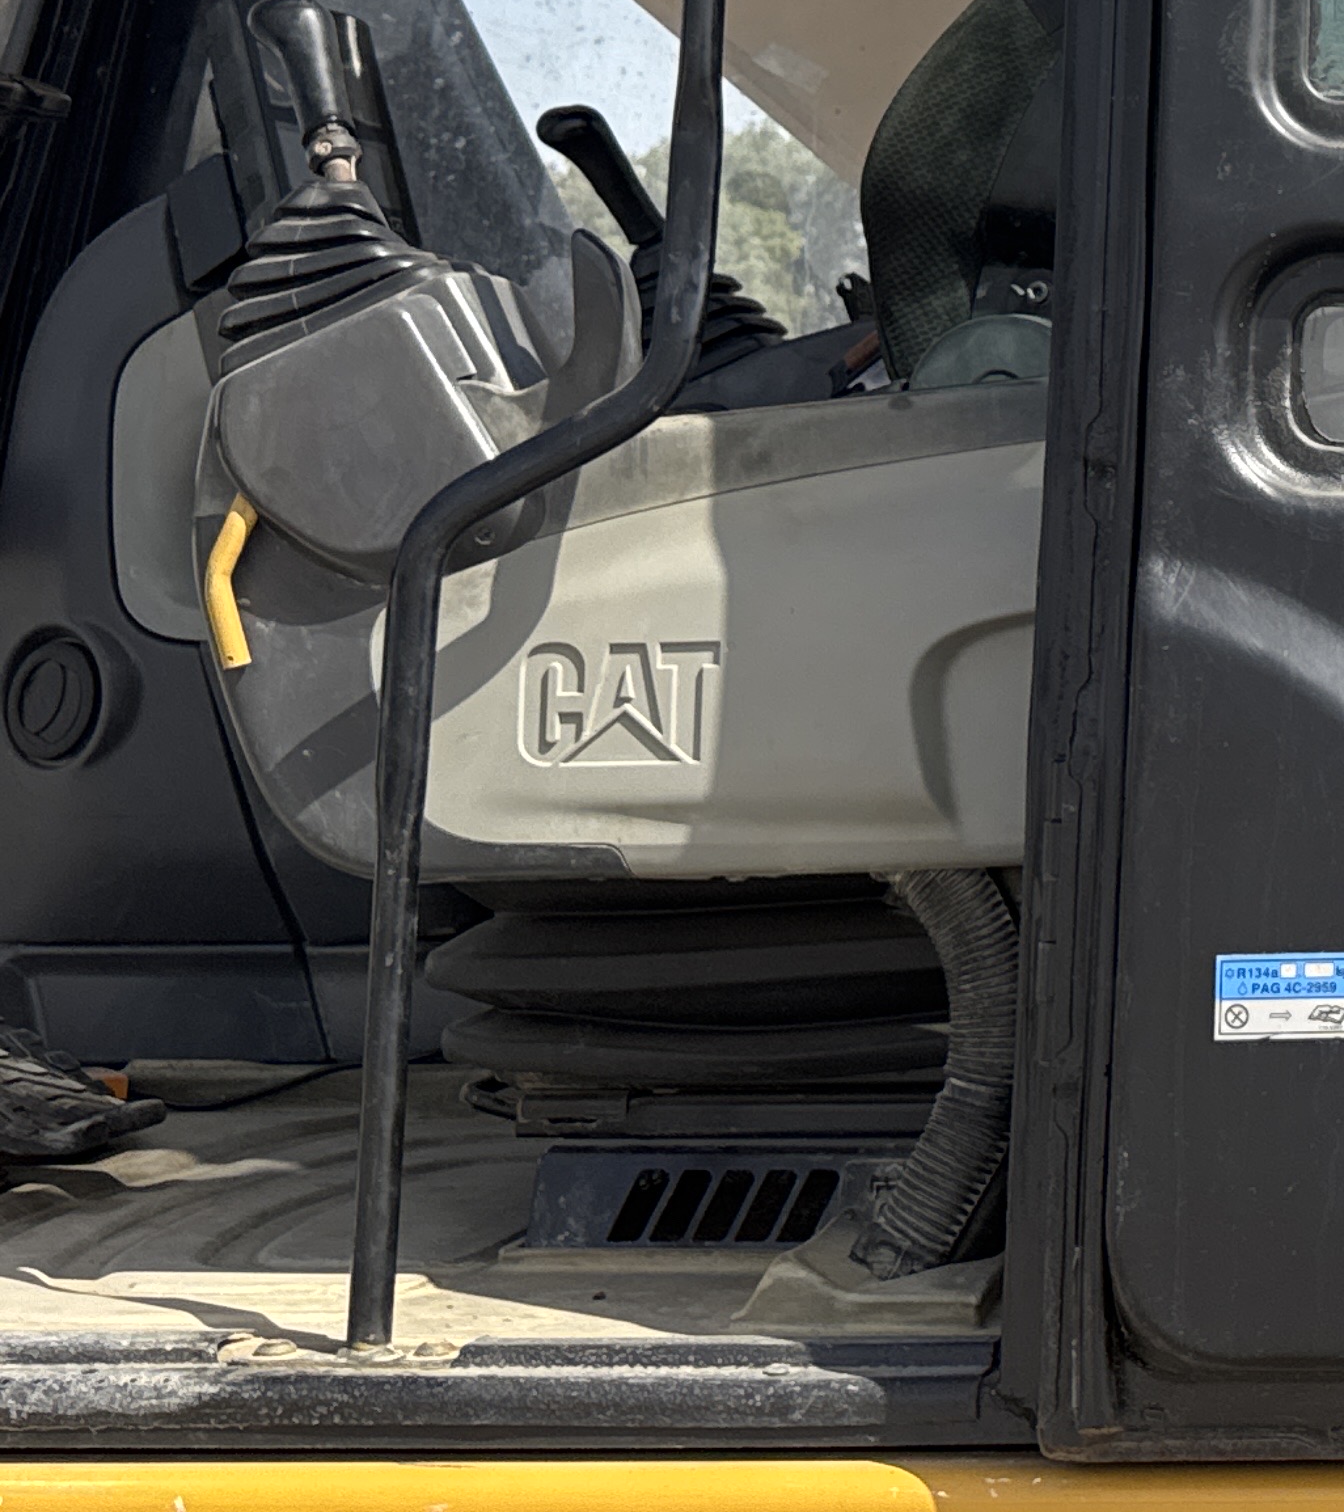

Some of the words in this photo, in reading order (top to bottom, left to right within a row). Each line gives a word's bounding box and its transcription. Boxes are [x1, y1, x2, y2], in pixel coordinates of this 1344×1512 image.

[517, 641, 722, 767] CAT
[1237, 967, 1279, 979] R134a
[1251, 982, 1281, 994] PAG
